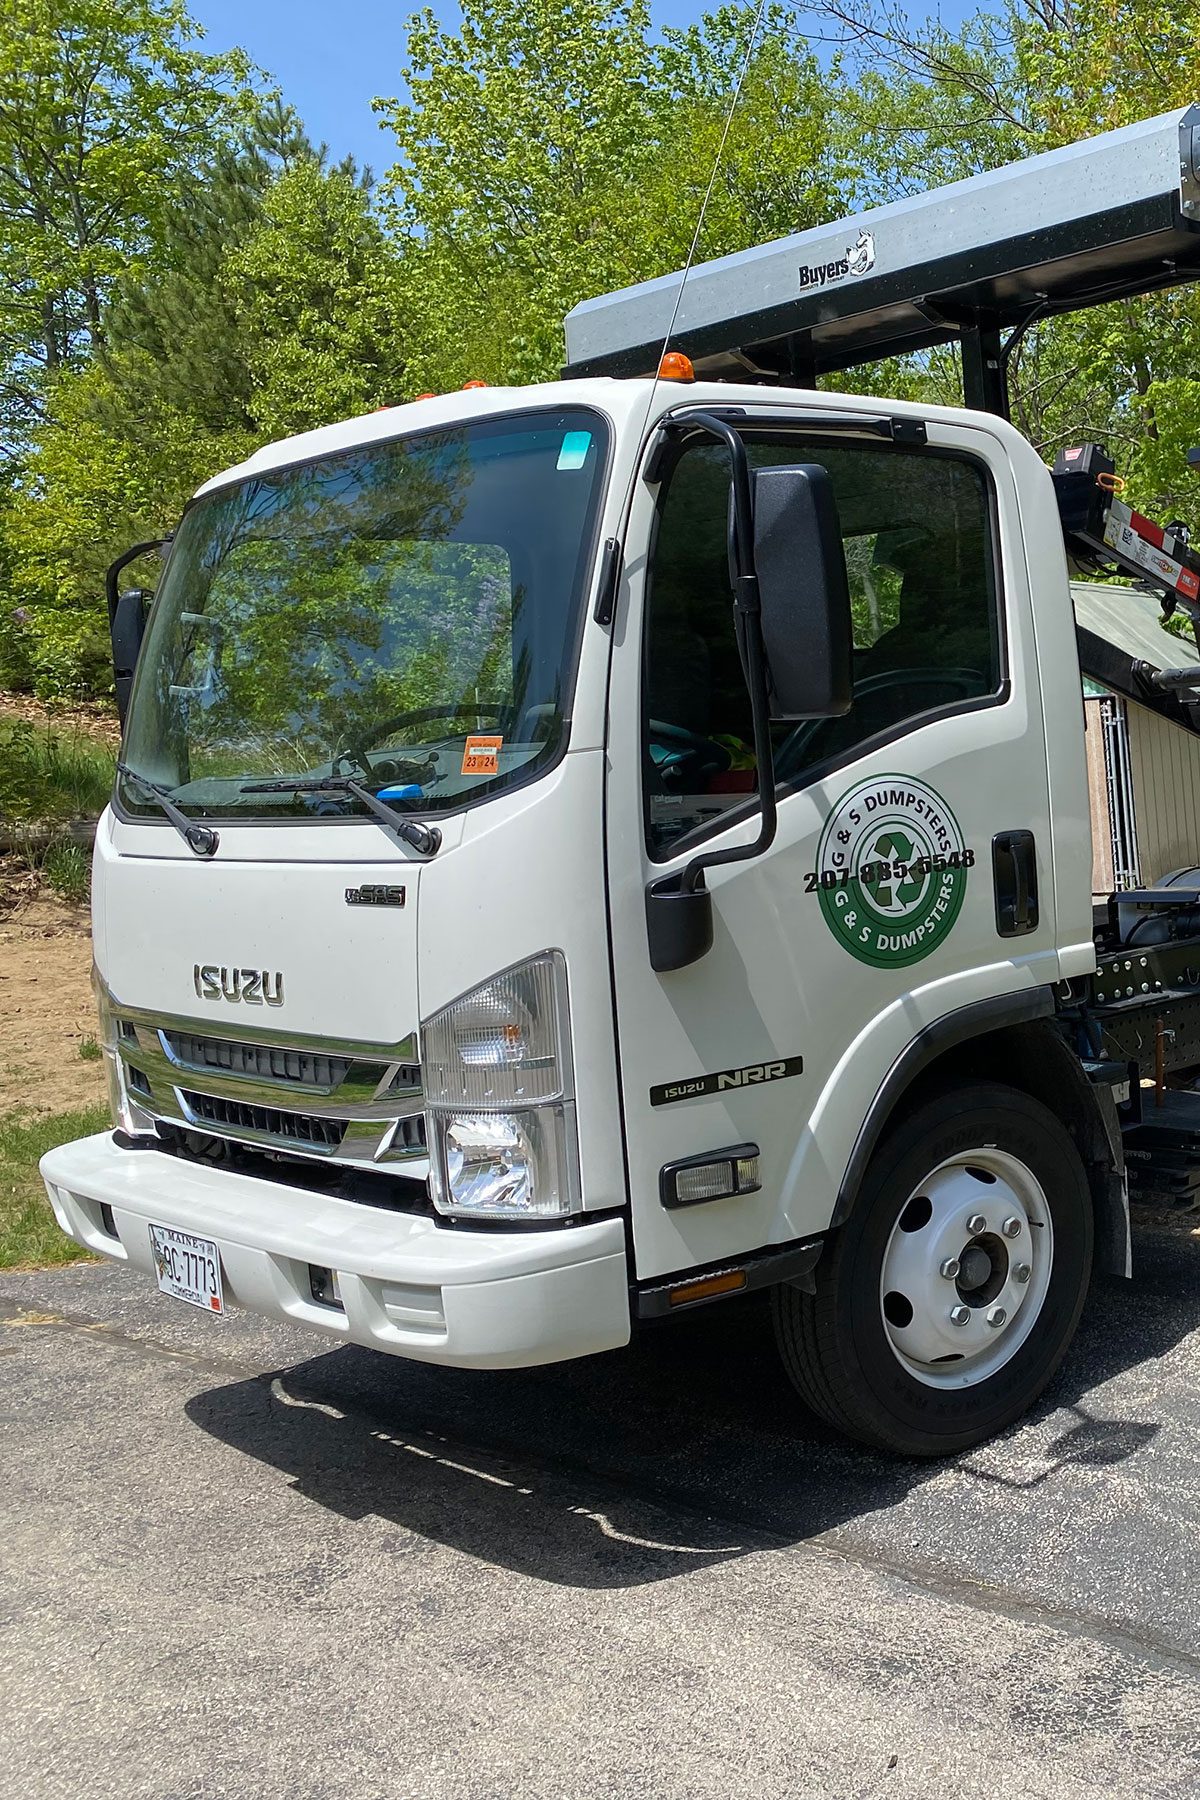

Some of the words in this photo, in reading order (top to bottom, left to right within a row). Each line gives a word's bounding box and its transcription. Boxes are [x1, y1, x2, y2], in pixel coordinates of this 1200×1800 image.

[799, 258, 849, 286] Buyers
[849, 808, 861, 826] S
[863, 790, 952, 852] DUMPSTERS
[837, 829, 852, 845] &
[832, 851, 845, 867] G
[834, 890, 849, 908] G
[844, 910, 858, 930] &
[859, 926, 872, 942] S
[876, 873, 954, 951] DUMPSTERS
[193, 963, 285, 1007] ISUZU
[664, 1081, 705, 1098] ISUZU
[717, 1062, 786, 1090] NRR
[167, 1231, 199, 1249] MAINE
